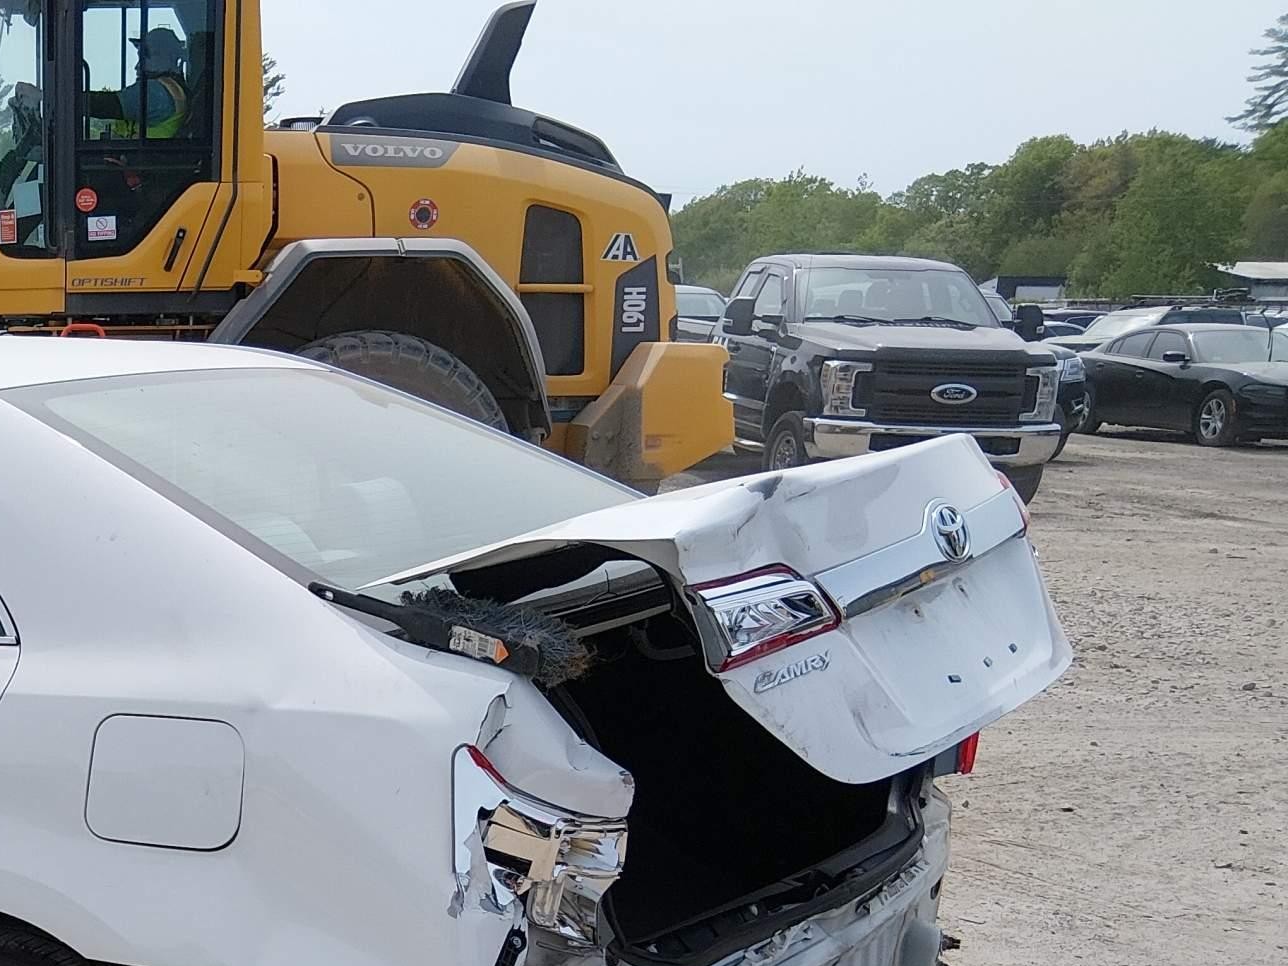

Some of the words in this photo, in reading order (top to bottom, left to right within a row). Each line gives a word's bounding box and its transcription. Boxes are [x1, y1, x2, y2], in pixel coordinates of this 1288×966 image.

[341, 143, 443, 159] VOLVO
[72, 277, 147, 287] OPTISHIFT
[622, 287, 647, 332] L90H
[943, 388, 966, 399] Ford
[754, 649, 830, 694] CAMRY
